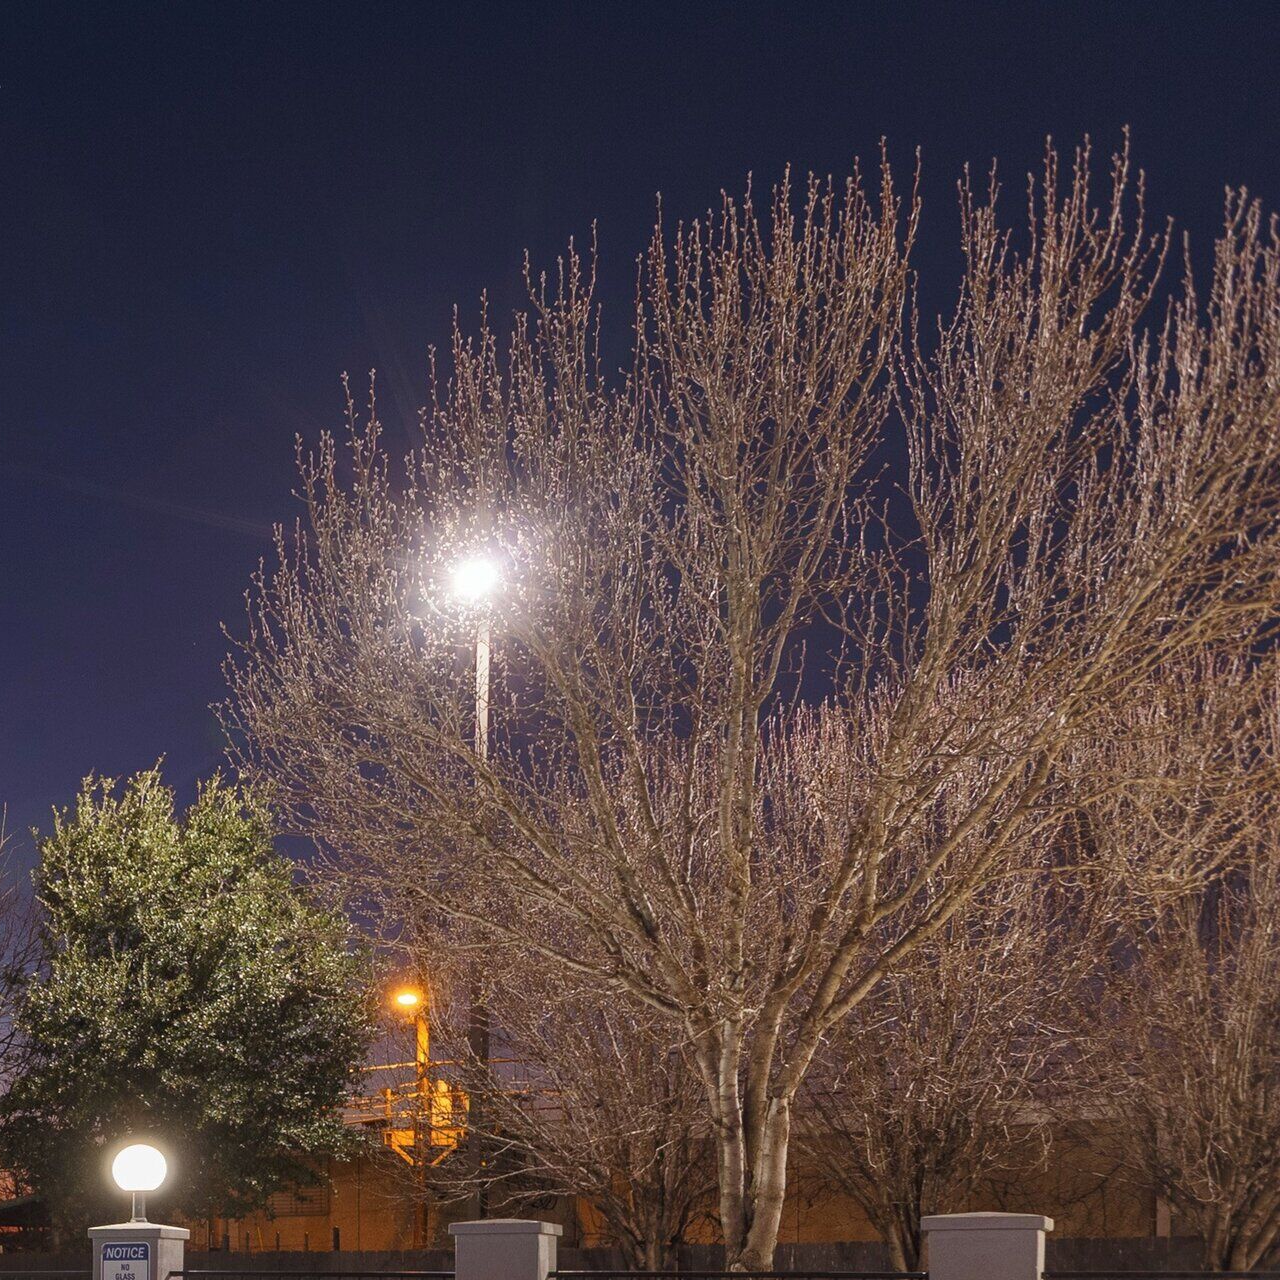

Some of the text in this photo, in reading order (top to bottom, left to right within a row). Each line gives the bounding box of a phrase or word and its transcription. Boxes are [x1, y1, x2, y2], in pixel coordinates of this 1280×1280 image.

[106, 1247, 145, 1259] NOTICE
[121, 1263, 130, 1271] NO
[115, 1273, 136, 1280] GLASS
